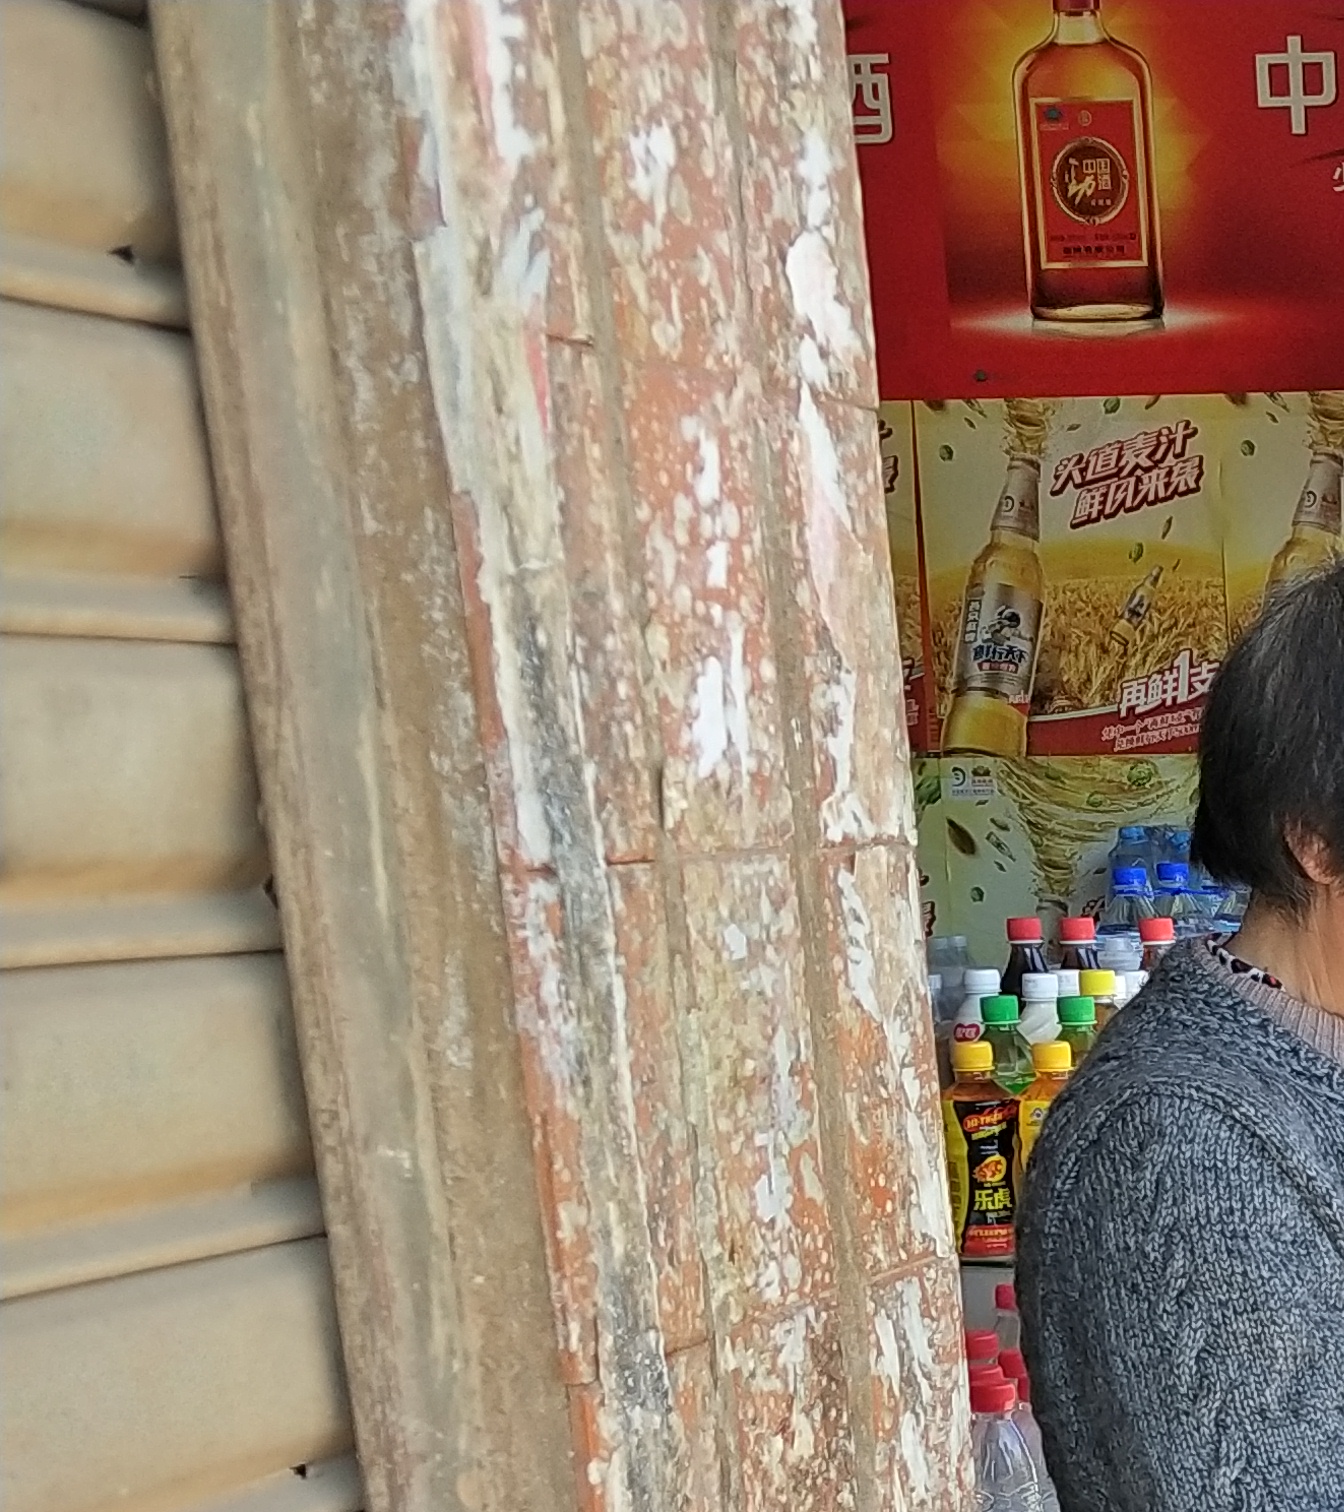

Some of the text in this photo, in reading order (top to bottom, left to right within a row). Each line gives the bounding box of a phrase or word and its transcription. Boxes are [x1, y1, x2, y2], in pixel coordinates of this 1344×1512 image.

[1051, 420, 1199, 496] 头道麦汁
[973, 1189, 1013, 1211] 乐虎
